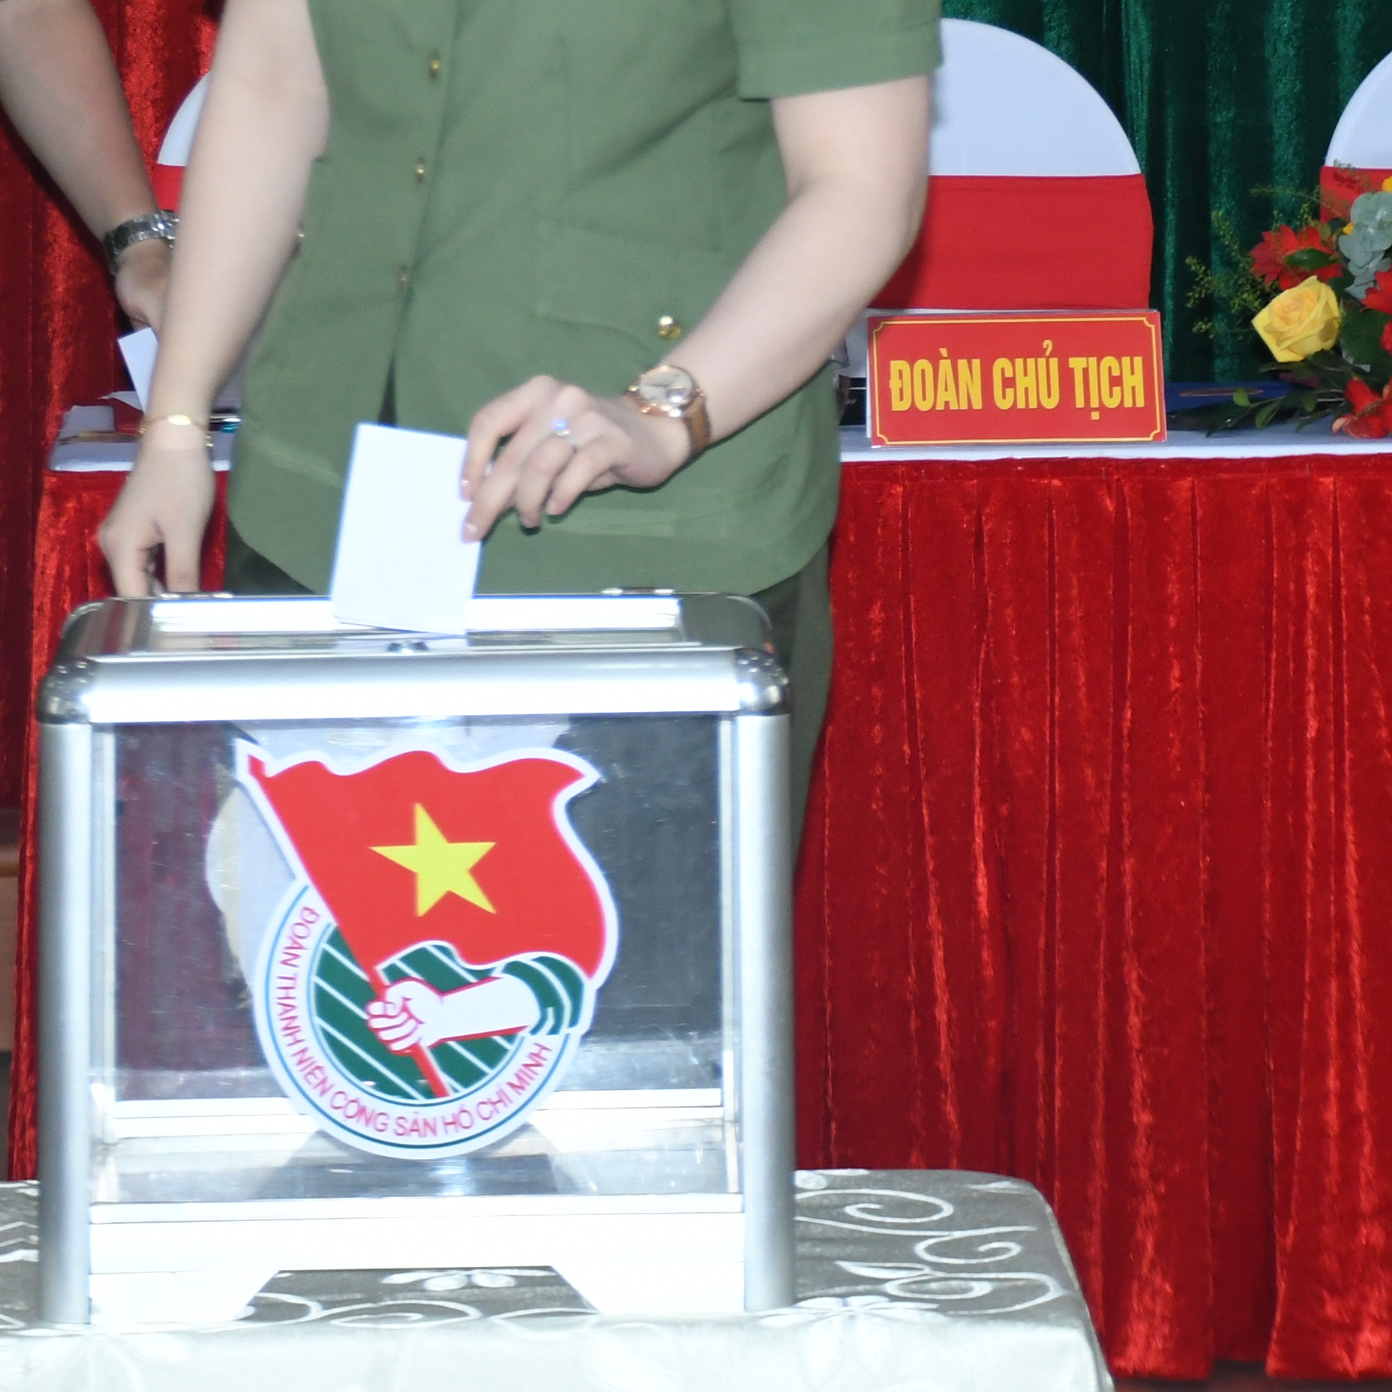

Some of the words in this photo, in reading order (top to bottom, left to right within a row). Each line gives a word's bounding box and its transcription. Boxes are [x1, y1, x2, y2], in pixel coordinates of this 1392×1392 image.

[889, 347, 983, 412] ĐOÀN
[992, 339, 1061, 410] CHỦ
[1068, 355, 1146, 420] TỊCH
[276, 972, 306, 1046] THANH
[330, 1089, 390, 1133] CỘNG
[506, 1042, 553, 1096] MINH
